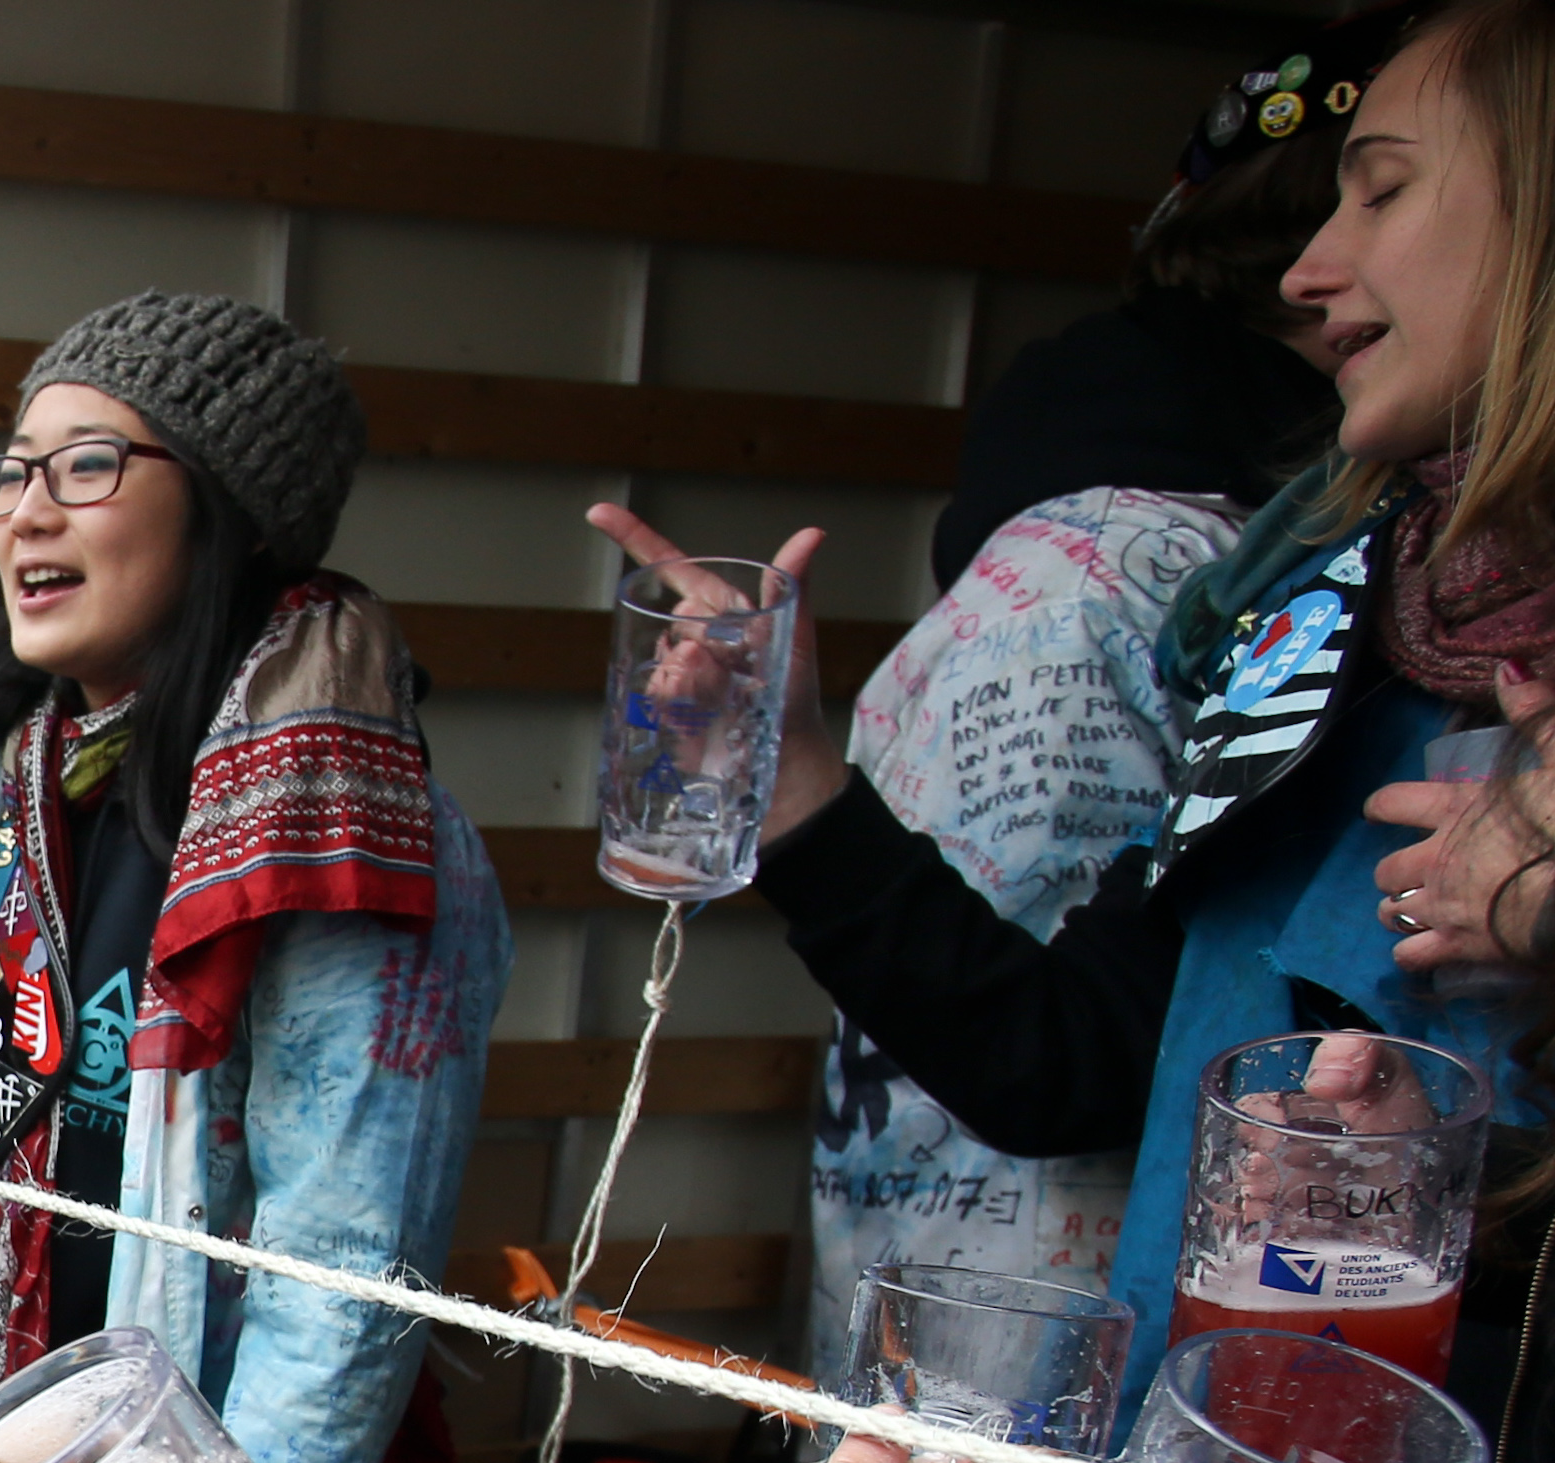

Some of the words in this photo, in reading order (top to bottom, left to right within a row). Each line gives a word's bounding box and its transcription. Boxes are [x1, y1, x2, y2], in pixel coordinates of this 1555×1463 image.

[1259, 603, 1337, 691] LIFE
[1233, 662, 1270, 691] I
[952, 677, 1012, 723] MON
[1030, 659, 1109, 688] PETIT
[1031, 753, 1112, 774] FAIRE
[991, 808, 1048, 842] GROS
[12, 970, 46, 1060] KIN
[1338, 1265, 1362, 1275] DES
[1365, 1259, 1418, 1274] ANCIENS
[1341, 1254, 1381, 1263] UNION
[1337, 1273, 1404, 1287] ETUDIANTS
[1334, 1288, 1351, 1298] DE
